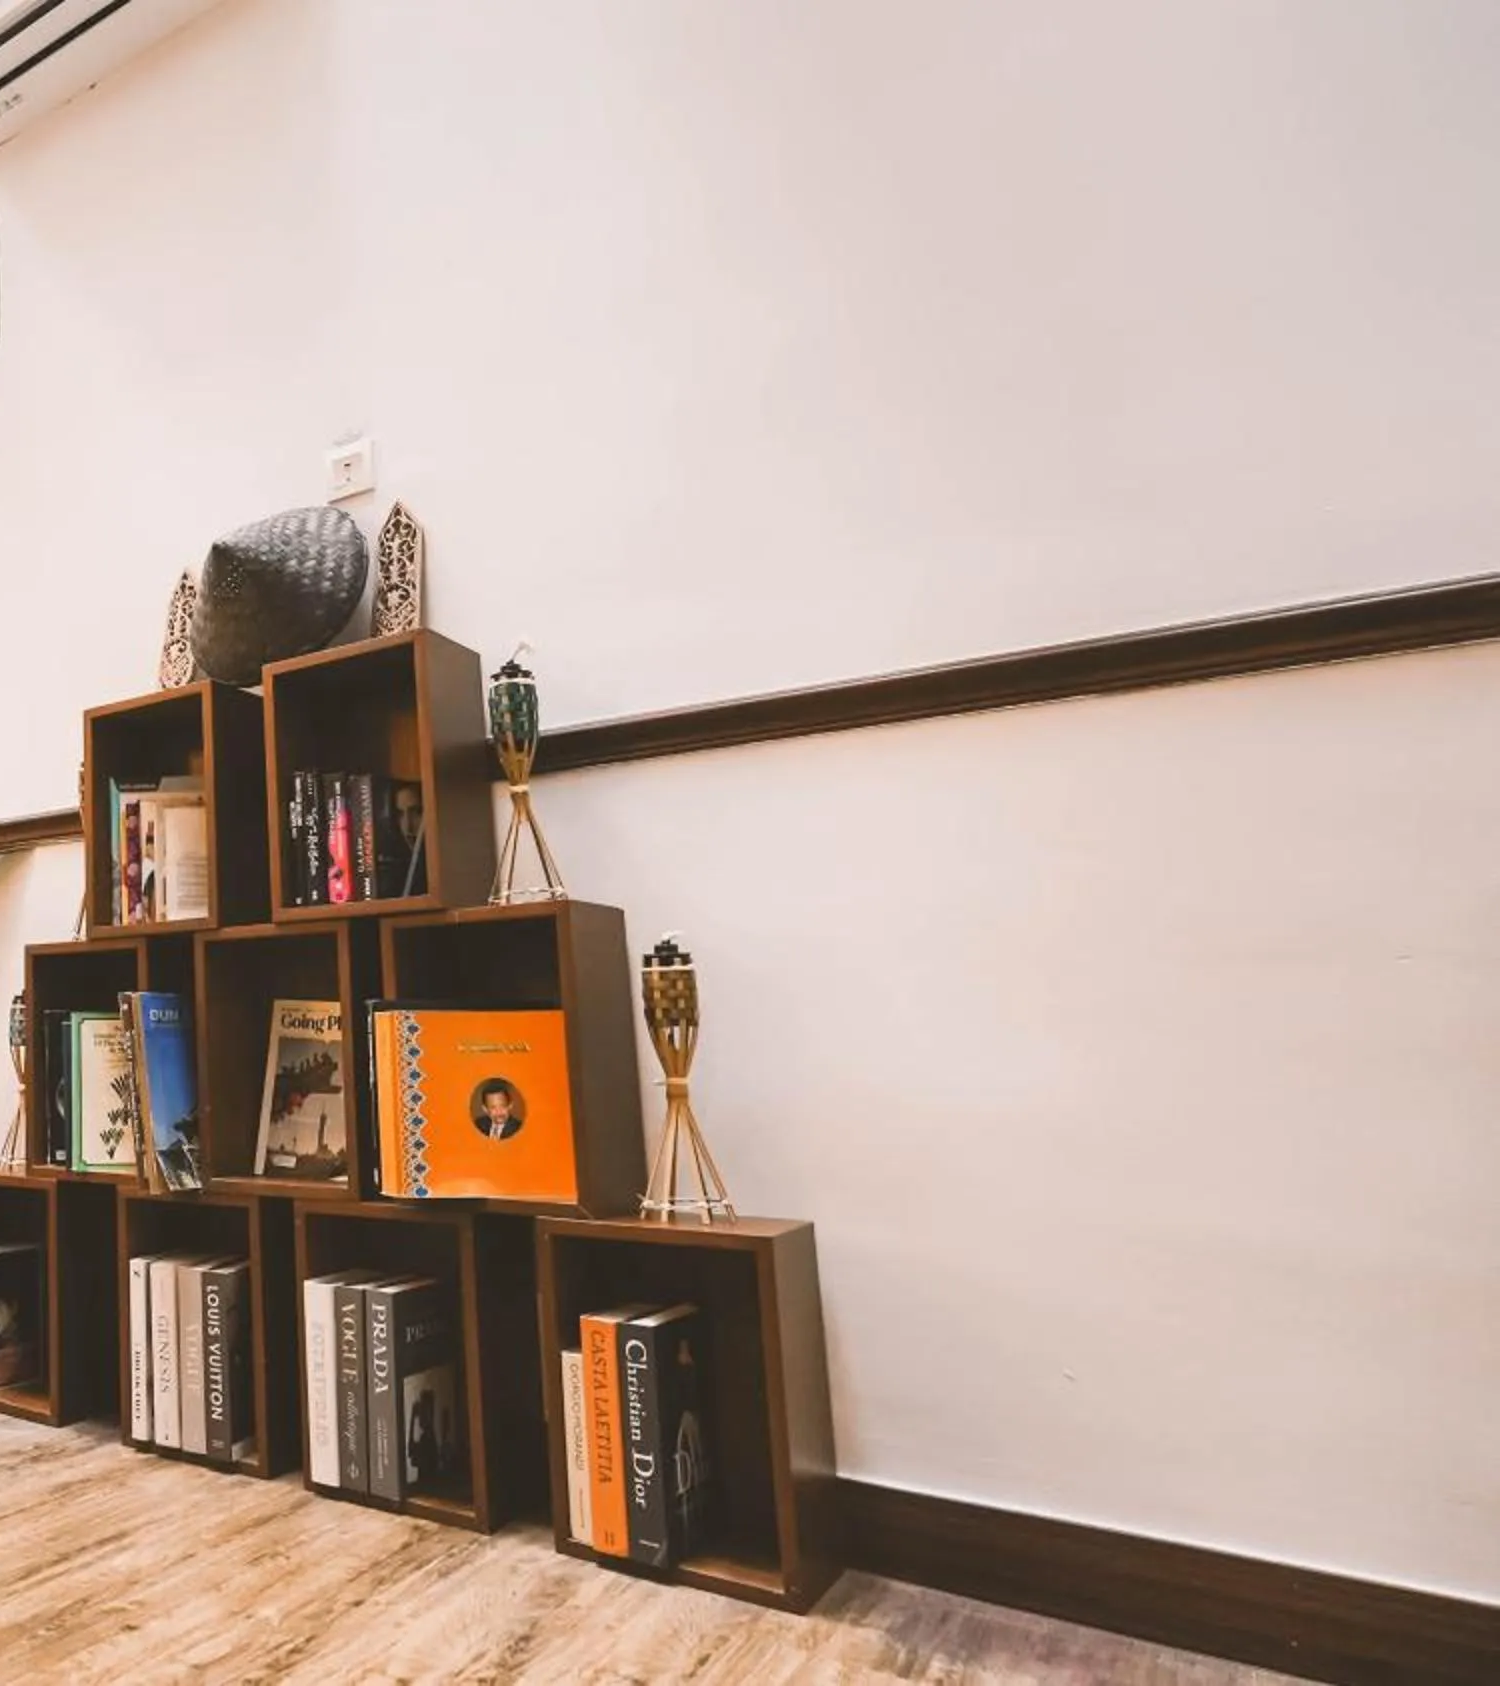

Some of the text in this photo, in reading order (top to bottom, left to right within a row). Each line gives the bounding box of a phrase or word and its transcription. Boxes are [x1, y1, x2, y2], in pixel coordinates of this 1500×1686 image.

[281, 1013, 326, 1034] Going
[156, 1315, 172, 1394] GENESIS
[185, 1323, 202, 1396] VOGUE
[206, 1284, 224, 1421] LOUIS VUITTON
[341, 1303, 358, 1384] VOGUE
[371, 1303, 389, 1393] PRADA
[590, 1330, 613, 1484] CASTA LAETITIA
[625, 1339, 655, 1508] Christian Dior
